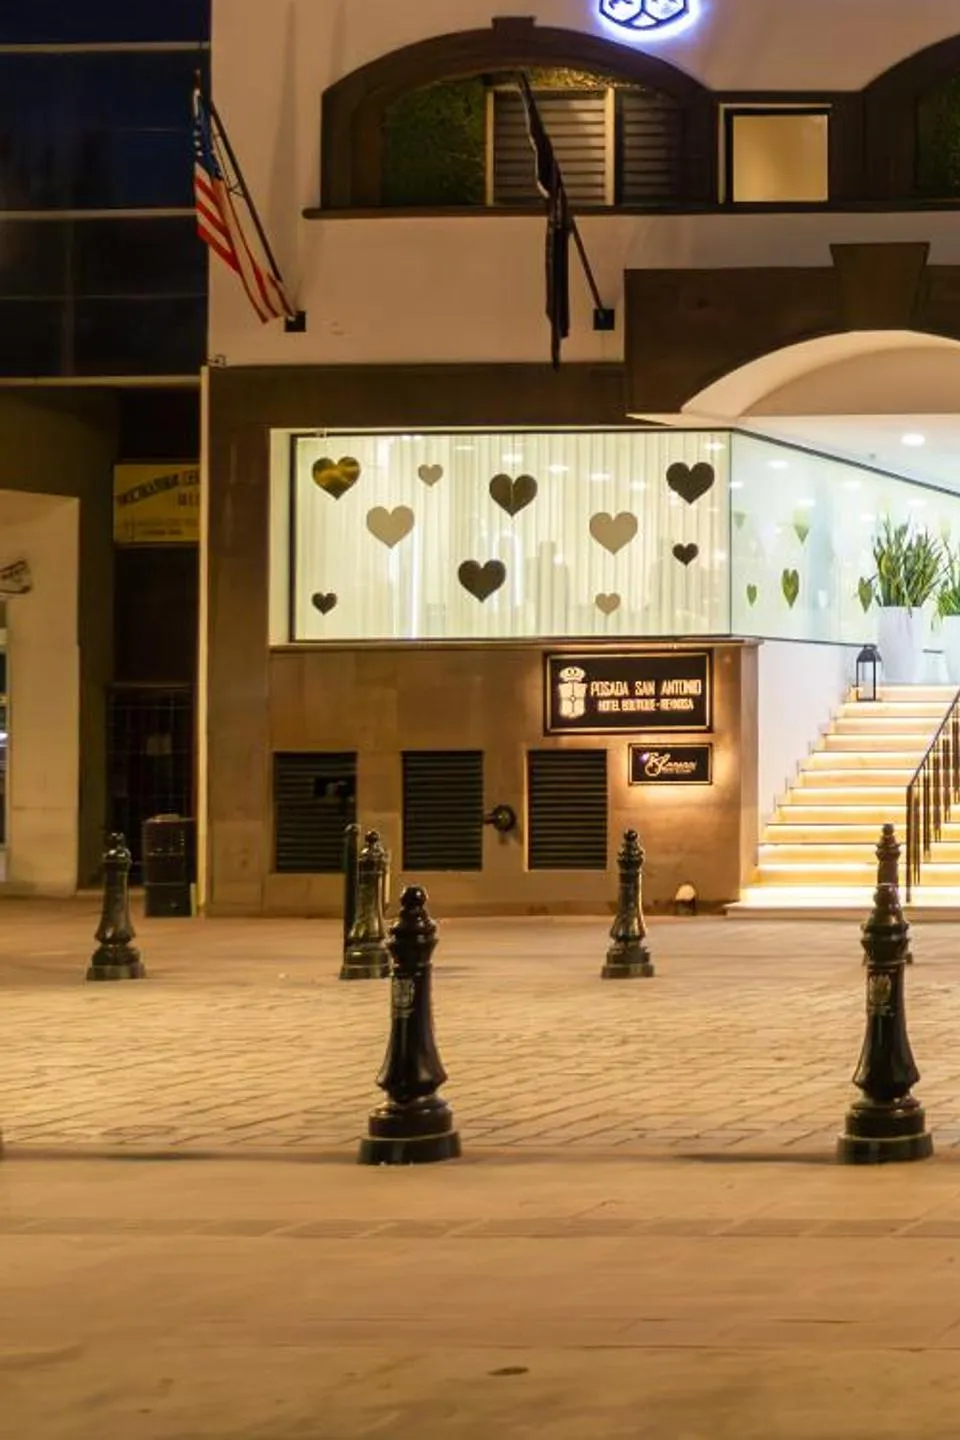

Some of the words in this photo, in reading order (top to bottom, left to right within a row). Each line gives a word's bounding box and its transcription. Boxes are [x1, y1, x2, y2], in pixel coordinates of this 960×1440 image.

[590, 680, 630, 697] POSADA
[634, 680, 656, 696] SAN
[661, 679, 702, 696] ANTONIO
[598, 699, 621, 712] HOTEL
